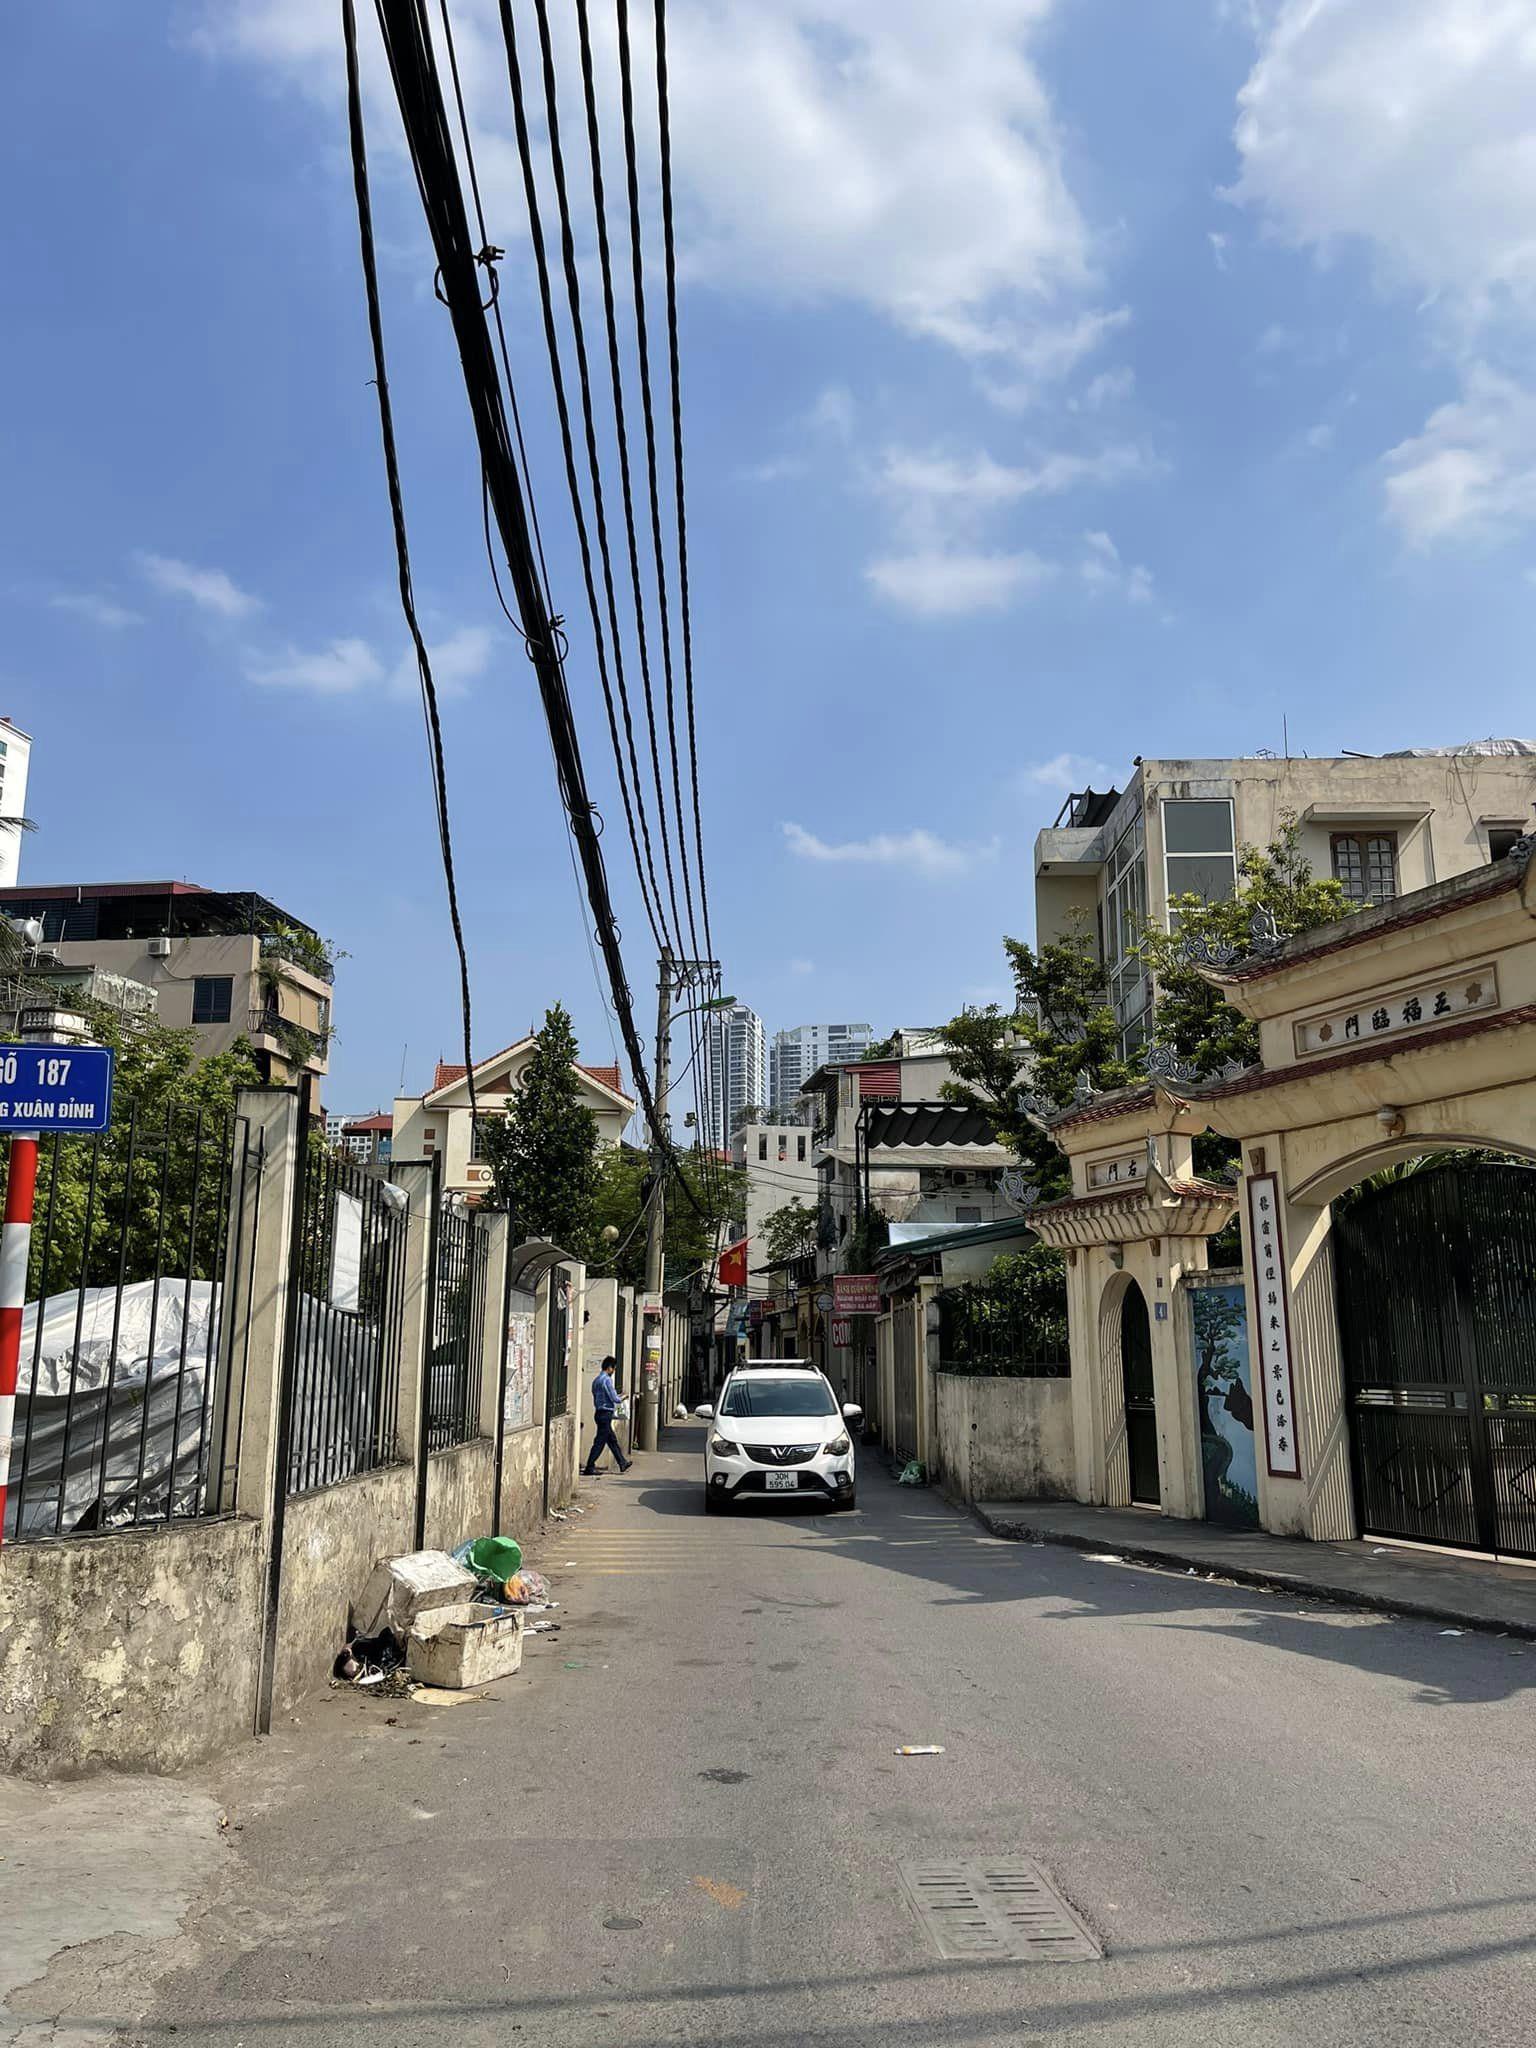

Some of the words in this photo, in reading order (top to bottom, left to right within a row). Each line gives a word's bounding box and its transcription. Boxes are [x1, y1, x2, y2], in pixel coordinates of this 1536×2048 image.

[37, 1058, 72, 1086] 187
[12, 1098, 55, 1118] XUÂN
[58, 1096, 95, 1119] ĐỈNH
